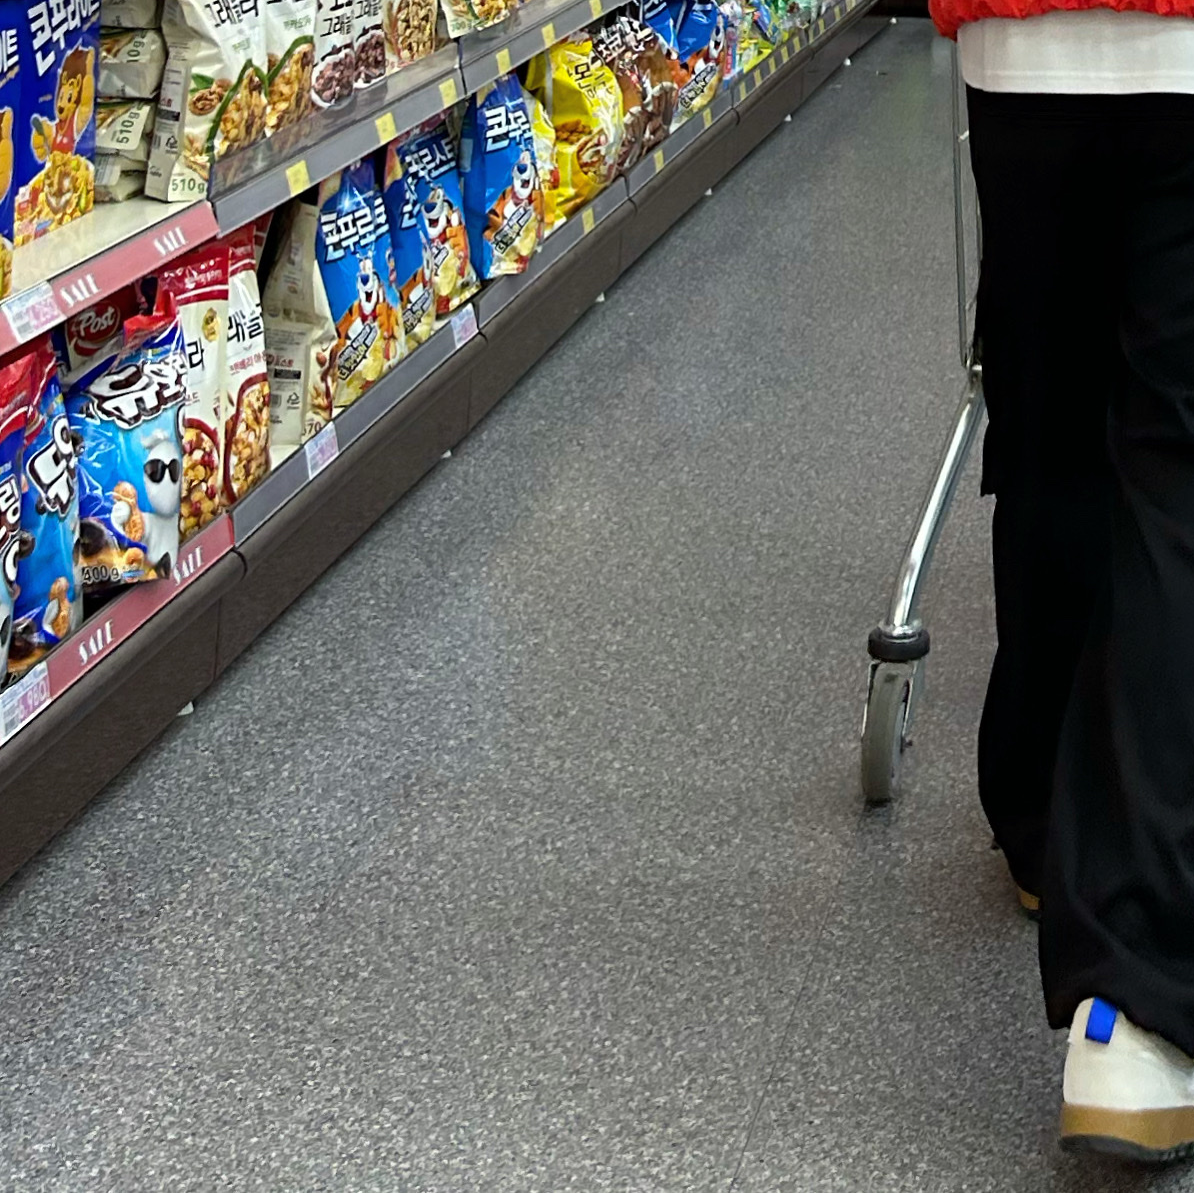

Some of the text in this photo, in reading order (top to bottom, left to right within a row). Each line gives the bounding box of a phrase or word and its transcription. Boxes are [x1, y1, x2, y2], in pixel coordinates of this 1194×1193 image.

[116, 103, 141, 146] 510g
[171, 176, 208, 194] 510g
[78, 306, 118, 334] Post
[173, 546, 204, 586] SALE
[78, 620, 115, 666] SALE
